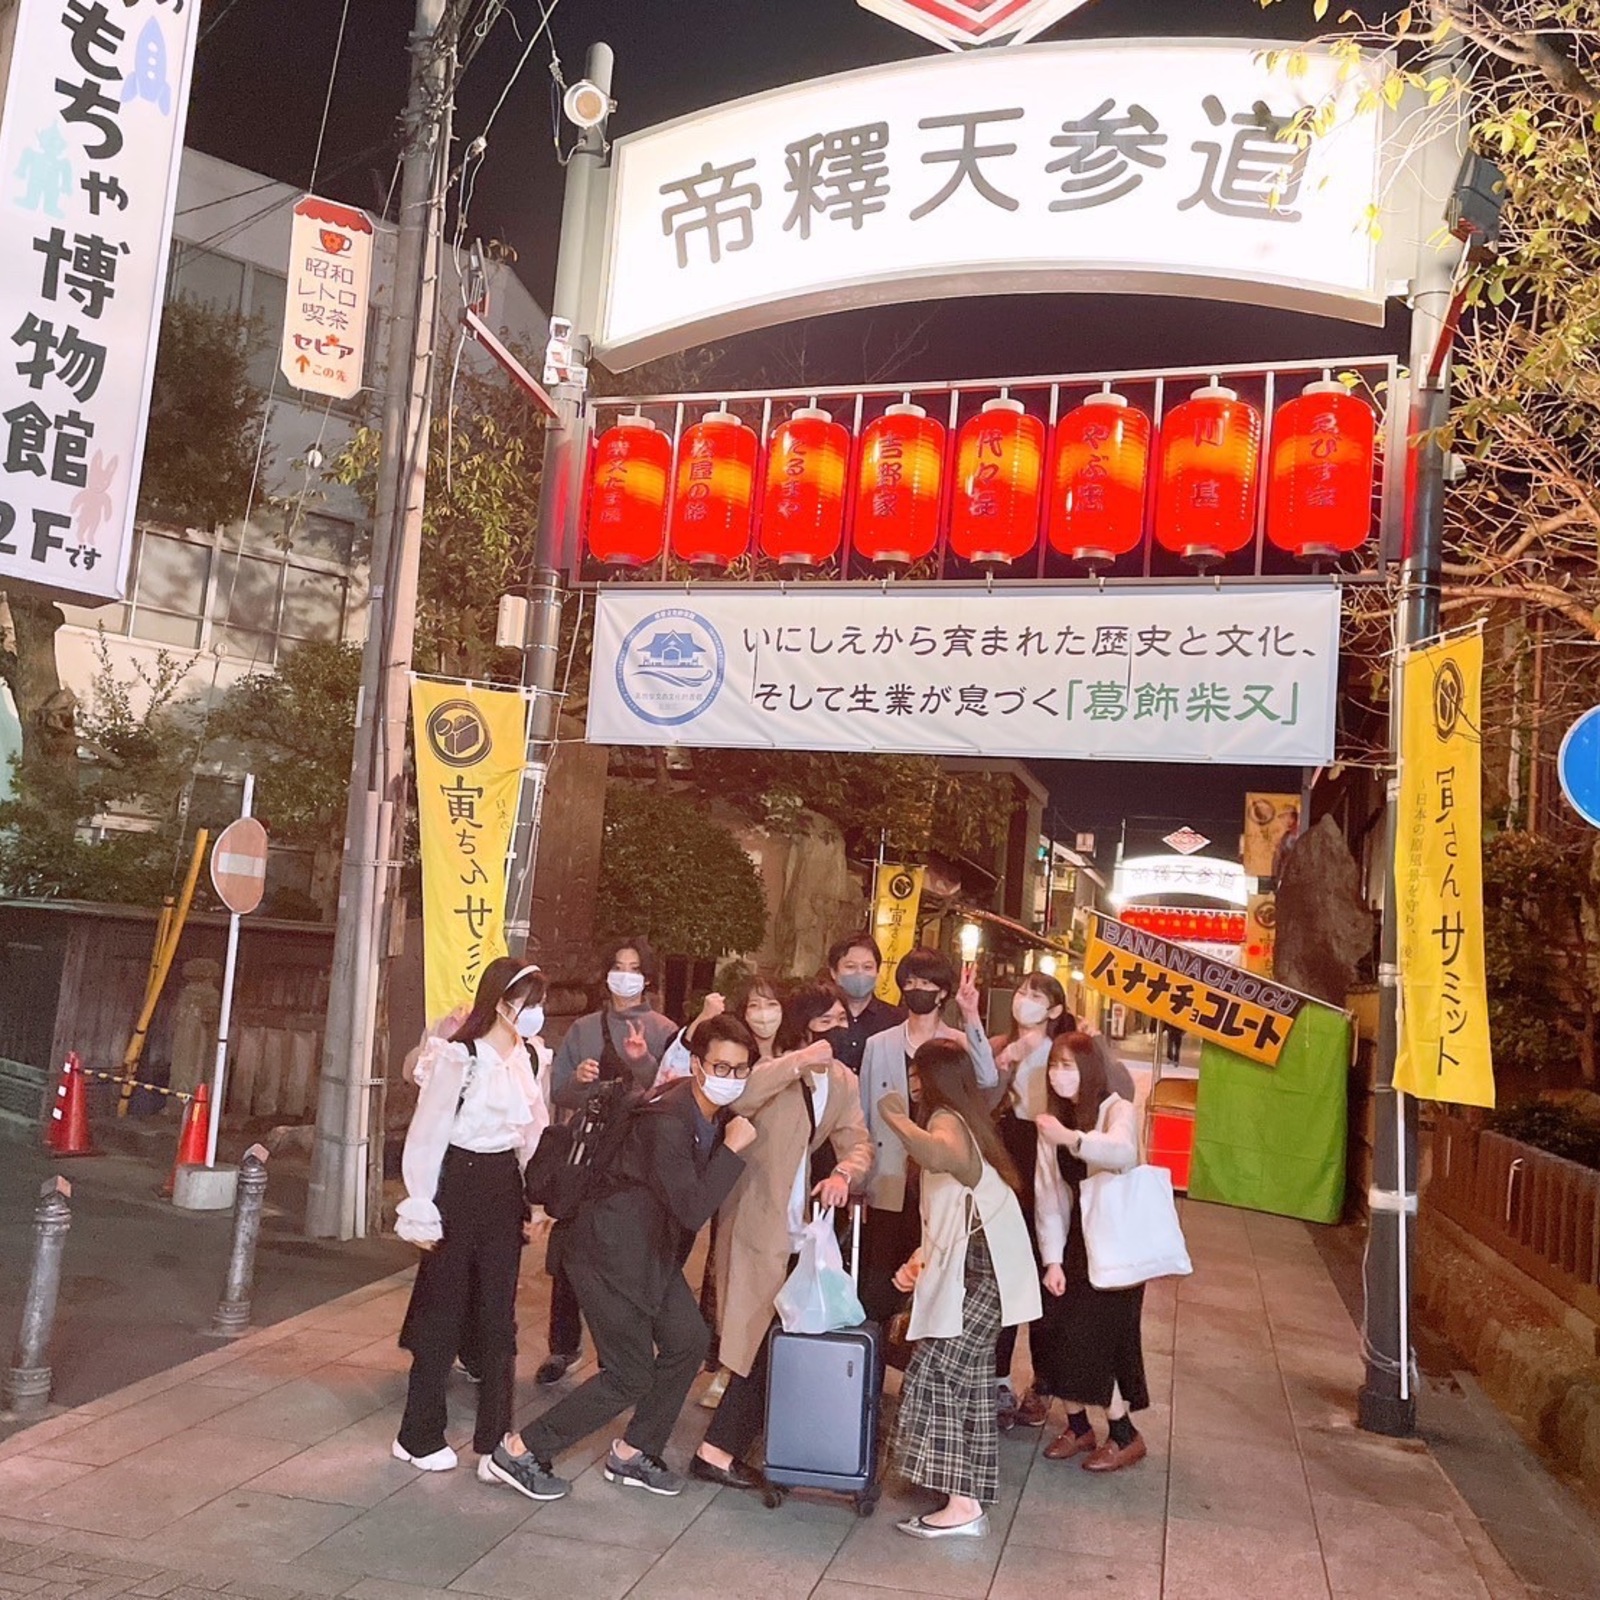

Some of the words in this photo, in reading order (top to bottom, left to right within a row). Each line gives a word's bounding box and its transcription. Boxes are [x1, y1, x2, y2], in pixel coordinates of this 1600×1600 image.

[659, 94, 1314, 269] 帝釋天参道
[2, 0, 183, 488] もちゃ博物館
[306, 257, 354, 285] 昭和
[298, 277, 357, 308] レトロ
[302, 302, 349, 331] 喫茶
[293, 333, 354, 360] セピア
[312, 364, 348, 382] この先
[872, 433, 904, 518] 吉野家
[743, 624, 1316, 657] いにしえから育まれた歴史と文化、
[754, 679, 1300, 725] そして生業が息づく「葛飾柴又」
[1090, 951, 1281, 1049] バナナチョコレート
